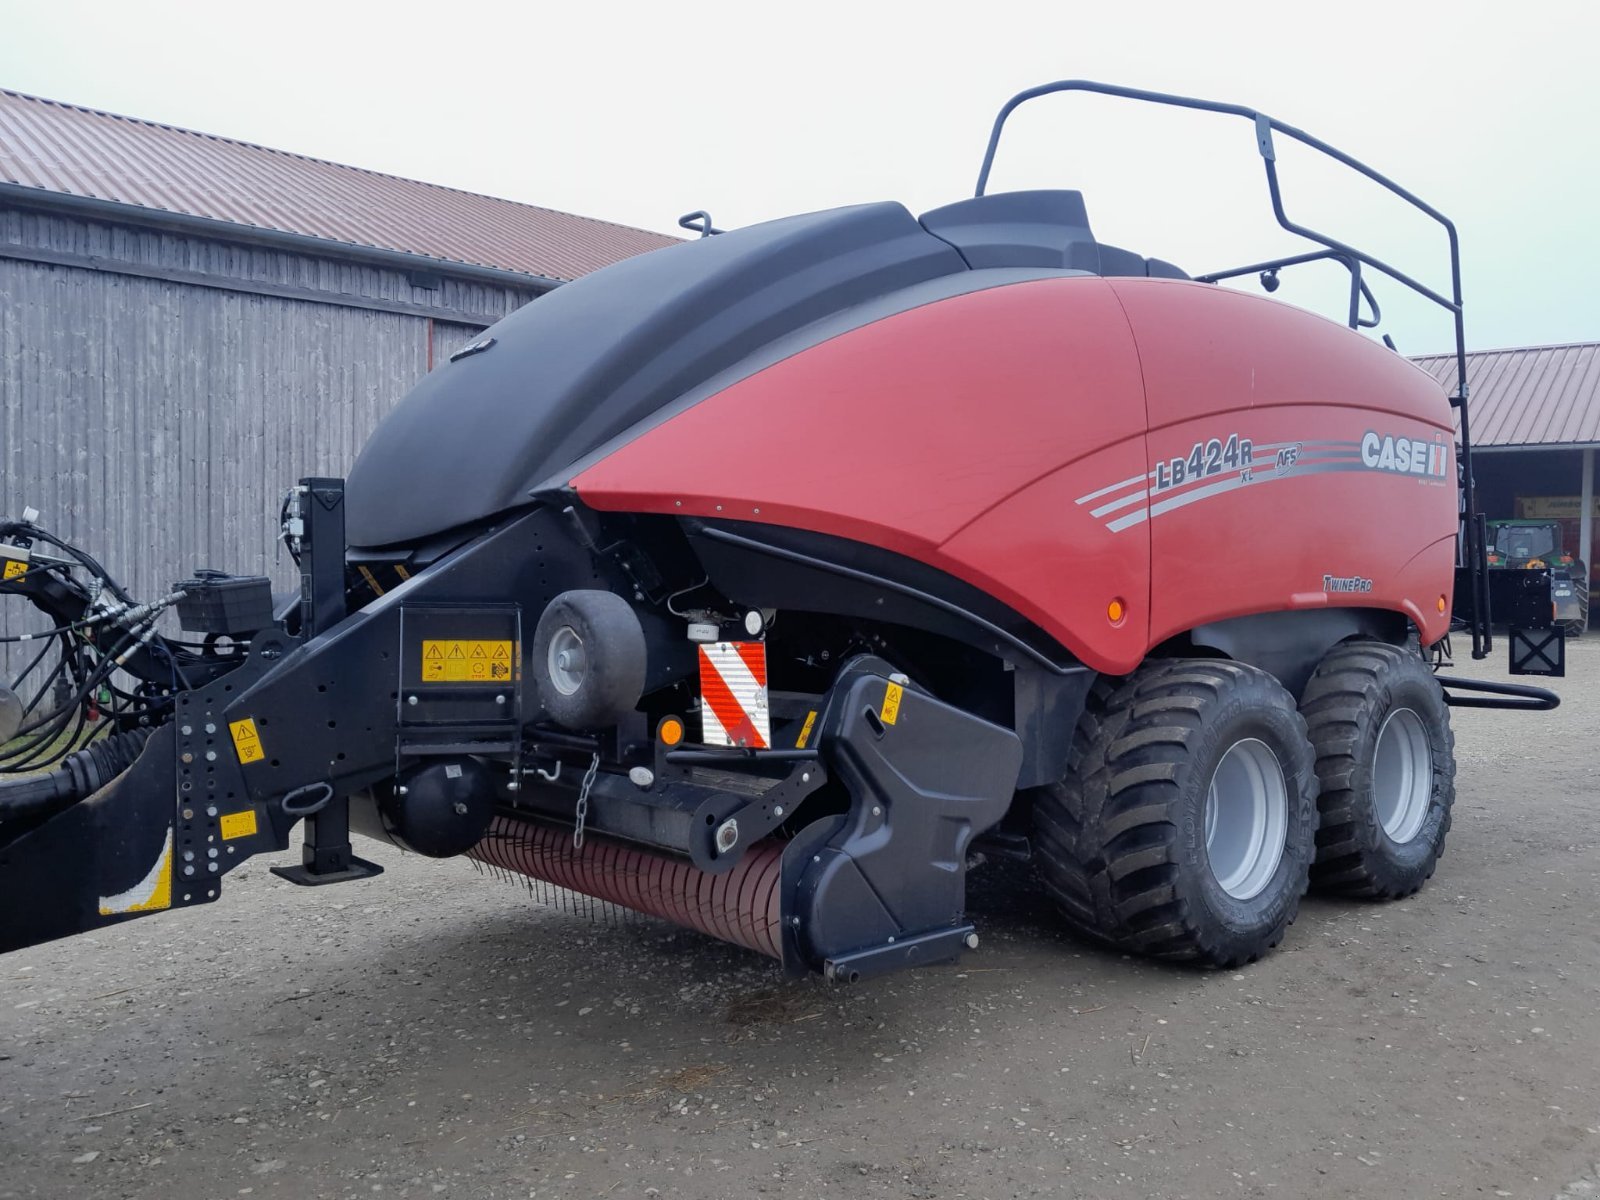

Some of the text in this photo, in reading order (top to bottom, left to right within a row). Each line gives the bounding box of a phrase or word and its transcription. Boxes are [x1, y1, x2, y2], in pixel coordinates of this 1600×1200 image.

[1275, 447, 1298, 469] AFS
[1361, 432, 1427, 474] CASE
[1239, 468, 1254, 483] XL
